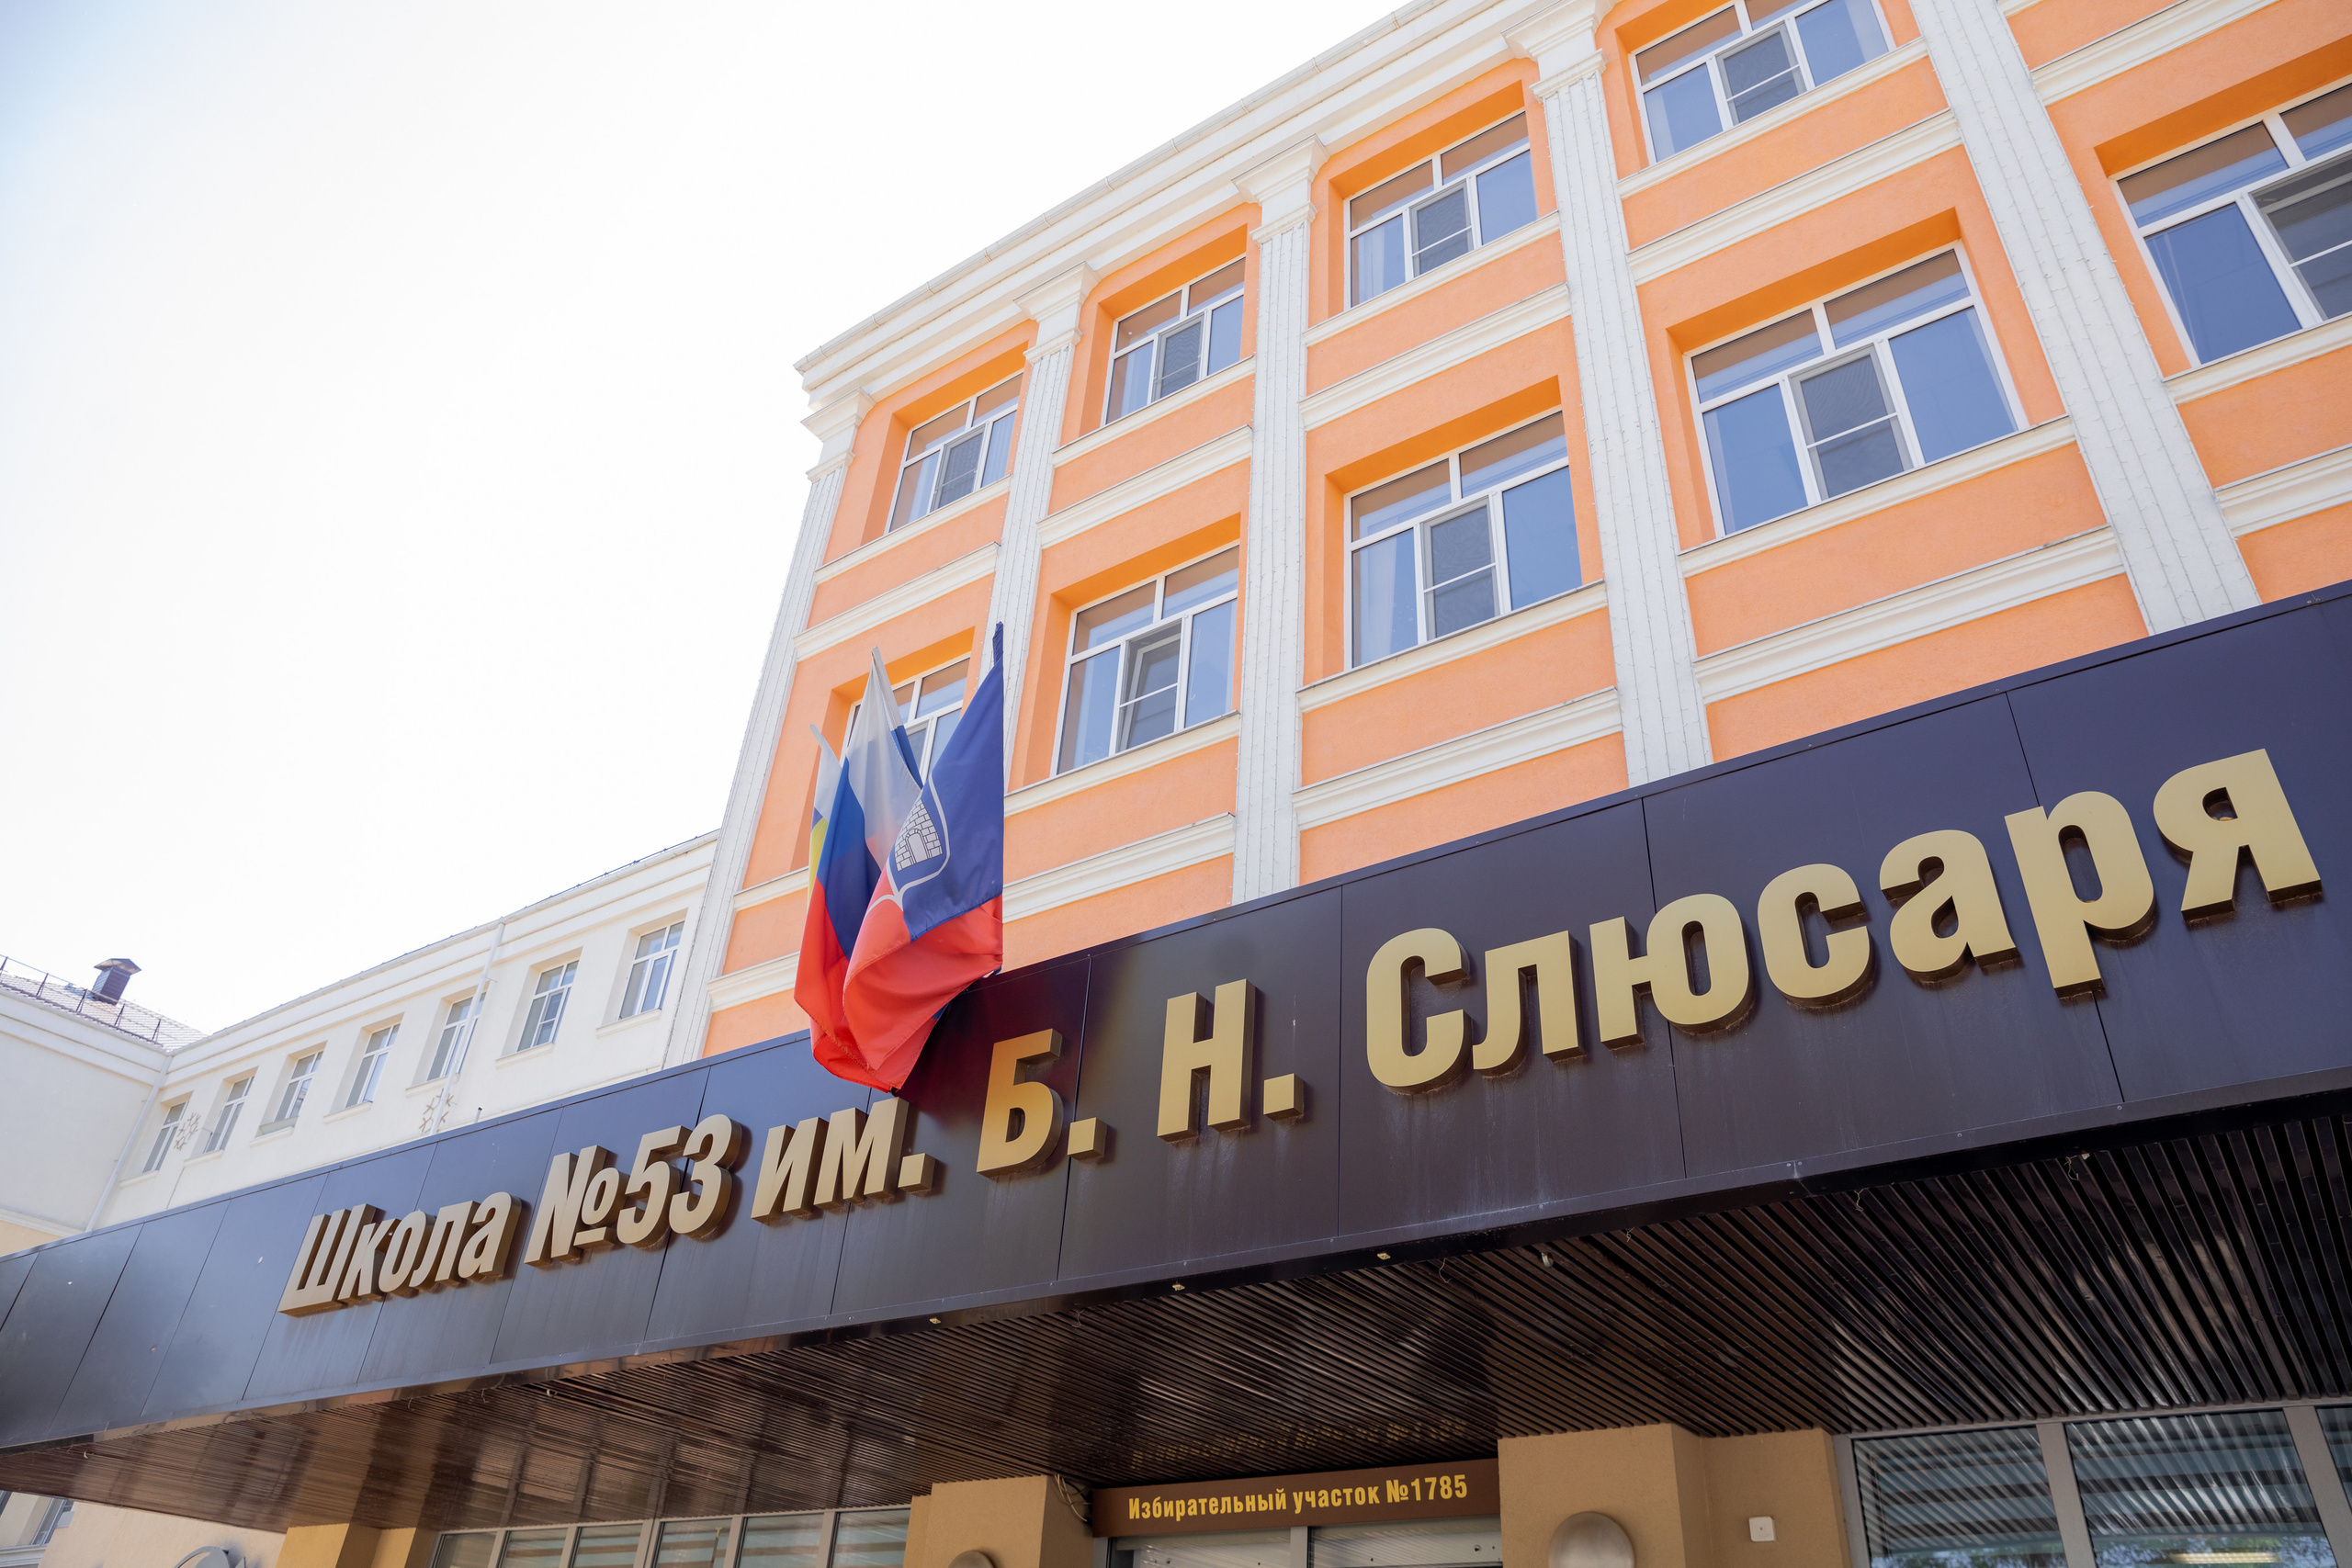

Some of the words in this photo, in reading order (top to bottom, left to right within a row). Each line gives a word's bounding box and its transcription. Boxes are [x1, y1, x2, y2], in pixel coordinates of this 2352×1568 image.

[277, 1189, 523, 1315] Школа
[524, 1114, 743, 1268] №53
[751, 1097, 936, 1223] им.
[976, 1029, 1110, 1177] Б.
[1157, 978, 1305, 1142] Н.
[1366, 747, 2323, 1095] Слюсаря
[1129, 1488, 1286, 1521] Избирательный
[1293, 1481, 1380, 1514] участок
[1386, 1473, 1468, 1504] №1785
